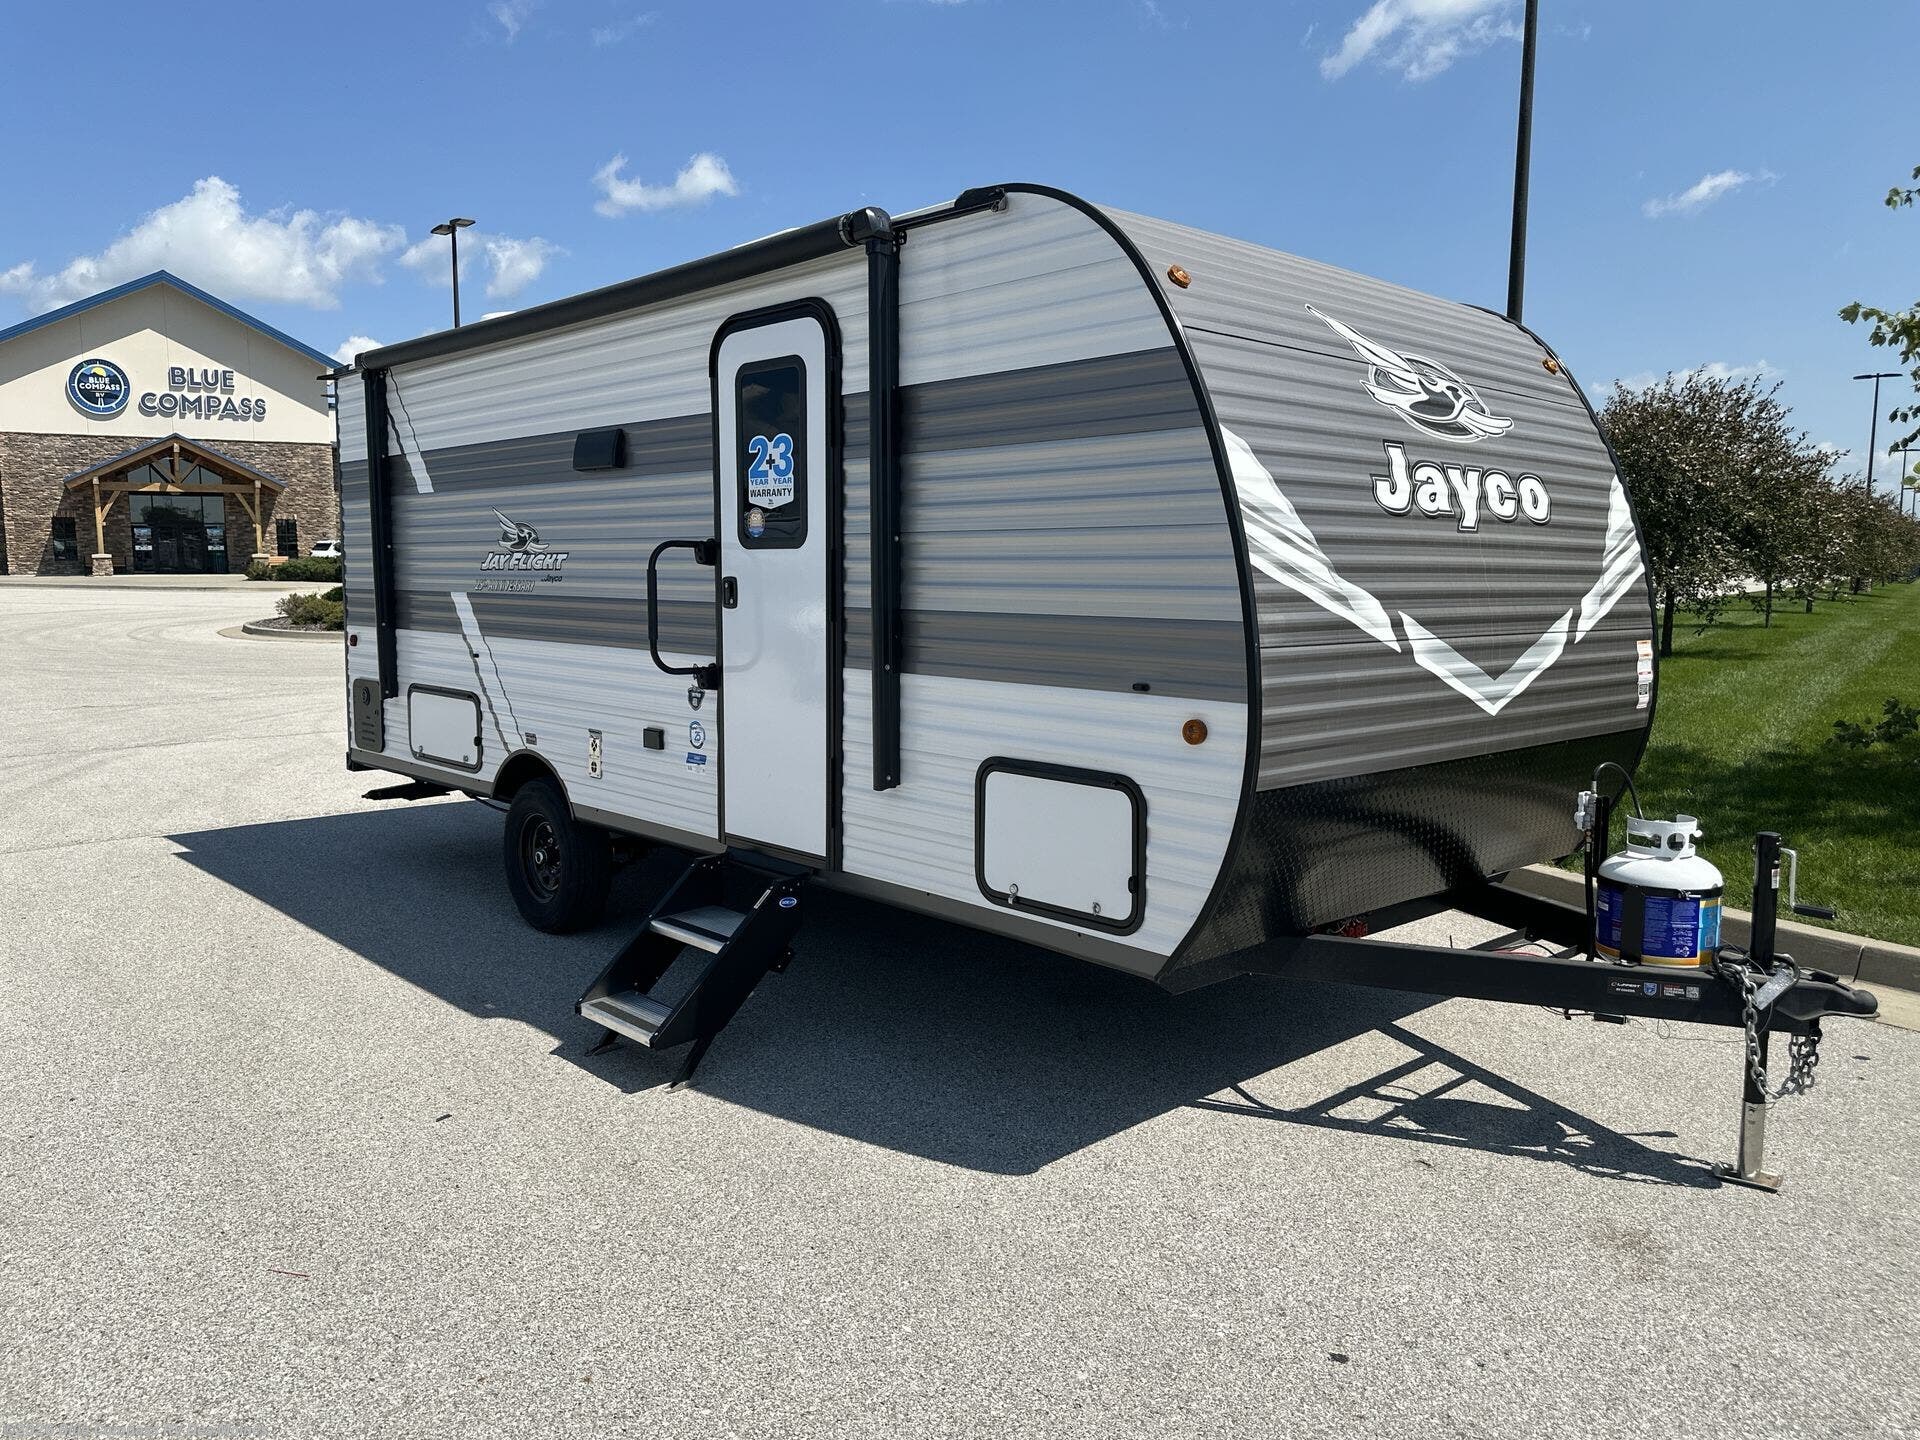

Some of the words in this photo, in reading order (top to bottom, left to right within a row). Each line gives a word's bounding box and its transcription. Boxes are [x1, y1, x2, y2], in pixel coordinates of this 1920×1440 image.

[89, 376, 110, 384] BLUE
[169, 366, 235, 388] BLUE
[79, 383, 121, 391] COMPASS
[140, 392, 267, 416] COMPASS
[773, 477, 792, 485] YEAR
[1370, 439, 1552, 533] Jayco
[750, 487, 793, 498] WARRANTY
[480, 552, 511, 571] JAY
[508, 552, 569, 571] FLIGHT
